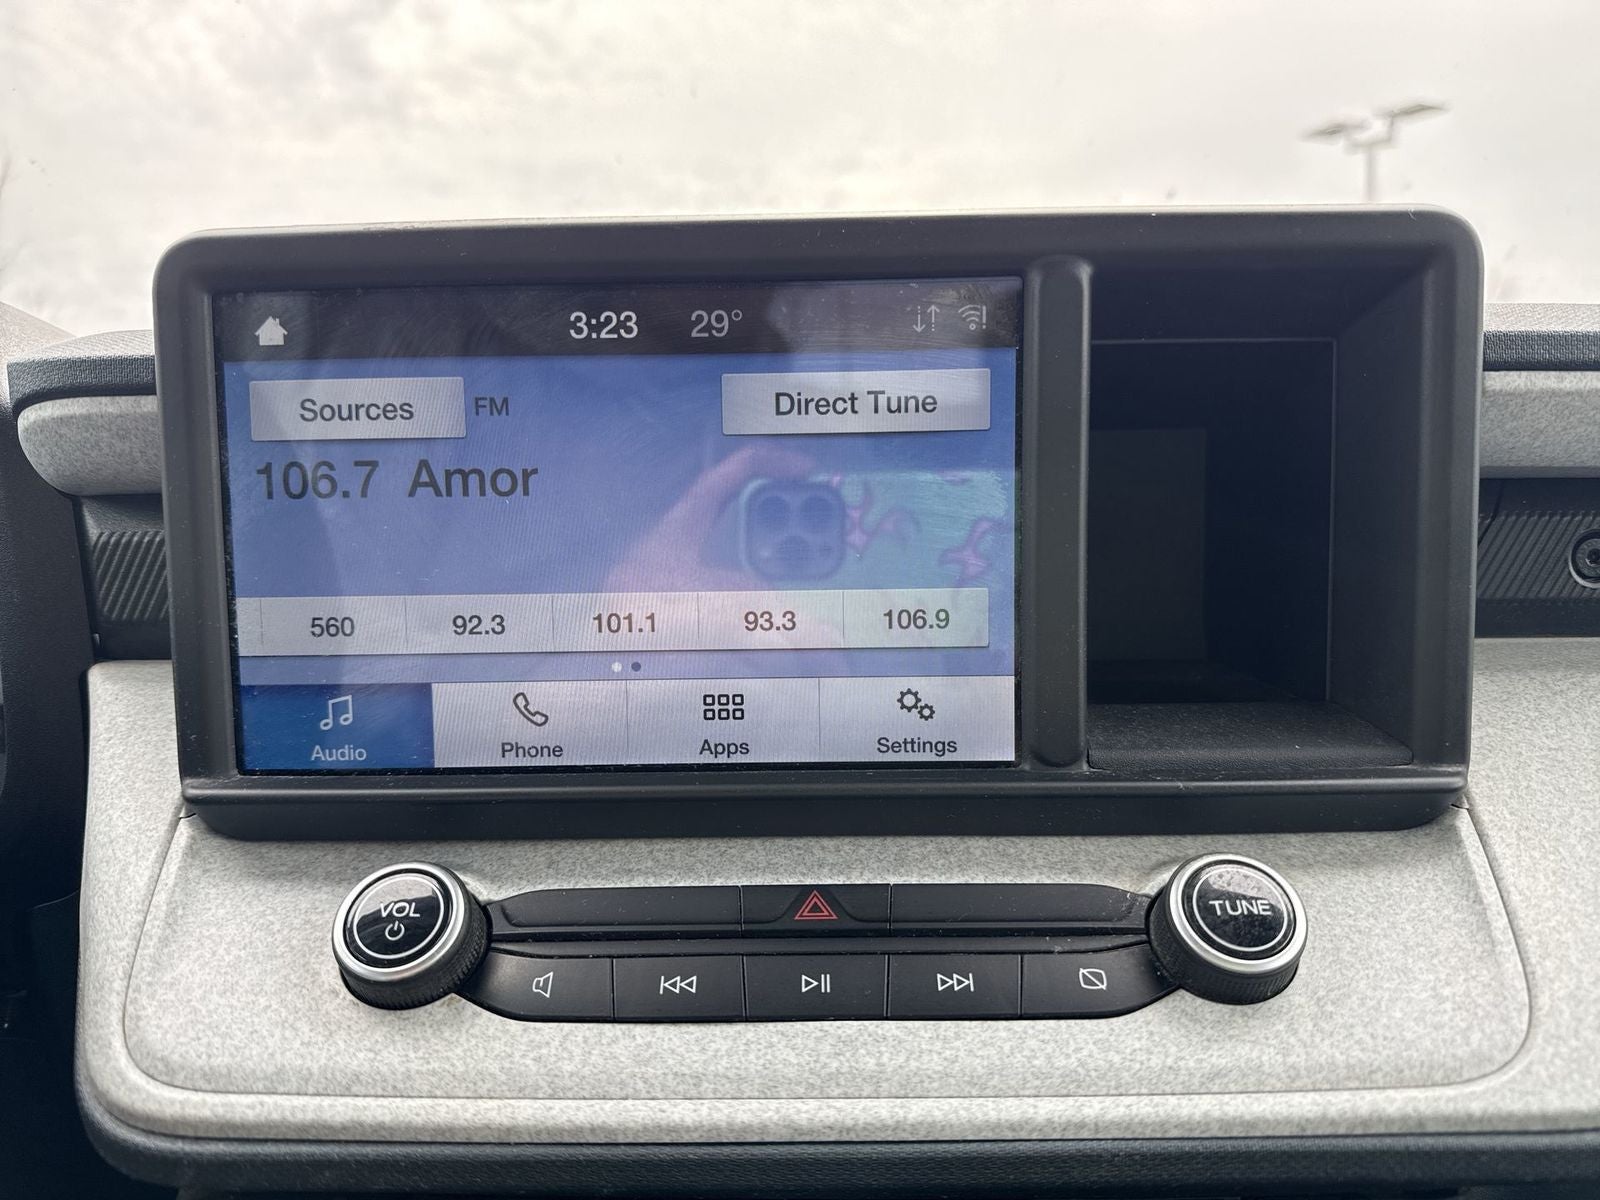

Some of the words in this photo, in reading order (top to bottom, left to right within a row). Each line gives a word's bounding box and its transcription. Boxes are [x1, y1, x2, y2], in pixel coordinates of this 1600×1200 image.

[569, 311, 639, 340] 3:23
[299, 398, 415, 423] Sources
[474, 396, 510, 417] FM
[774, 391, 859, 416] Direct
[867, 390, 938, 415] Tune
[256, 460, 380, 500] 106.7
[408, 459, 539, 498] Amor
[310, 616, 356, 638] 560
[452, 614, 506, 636] 92.3
[592, 612, 657, 634] 101.1
[743, 610, 797, 632] 93.3
[883, 608, 950, 631] 106.9
[311, 744, 367, 762] Audio
[501, 741, 564, 759] Phone
[700, 739, 750, 759] Apps
[876, 736, 958, 757] Settings
[380, 901, 421, 918] VOL
[1208, 899, 1273, 917] TUNE
